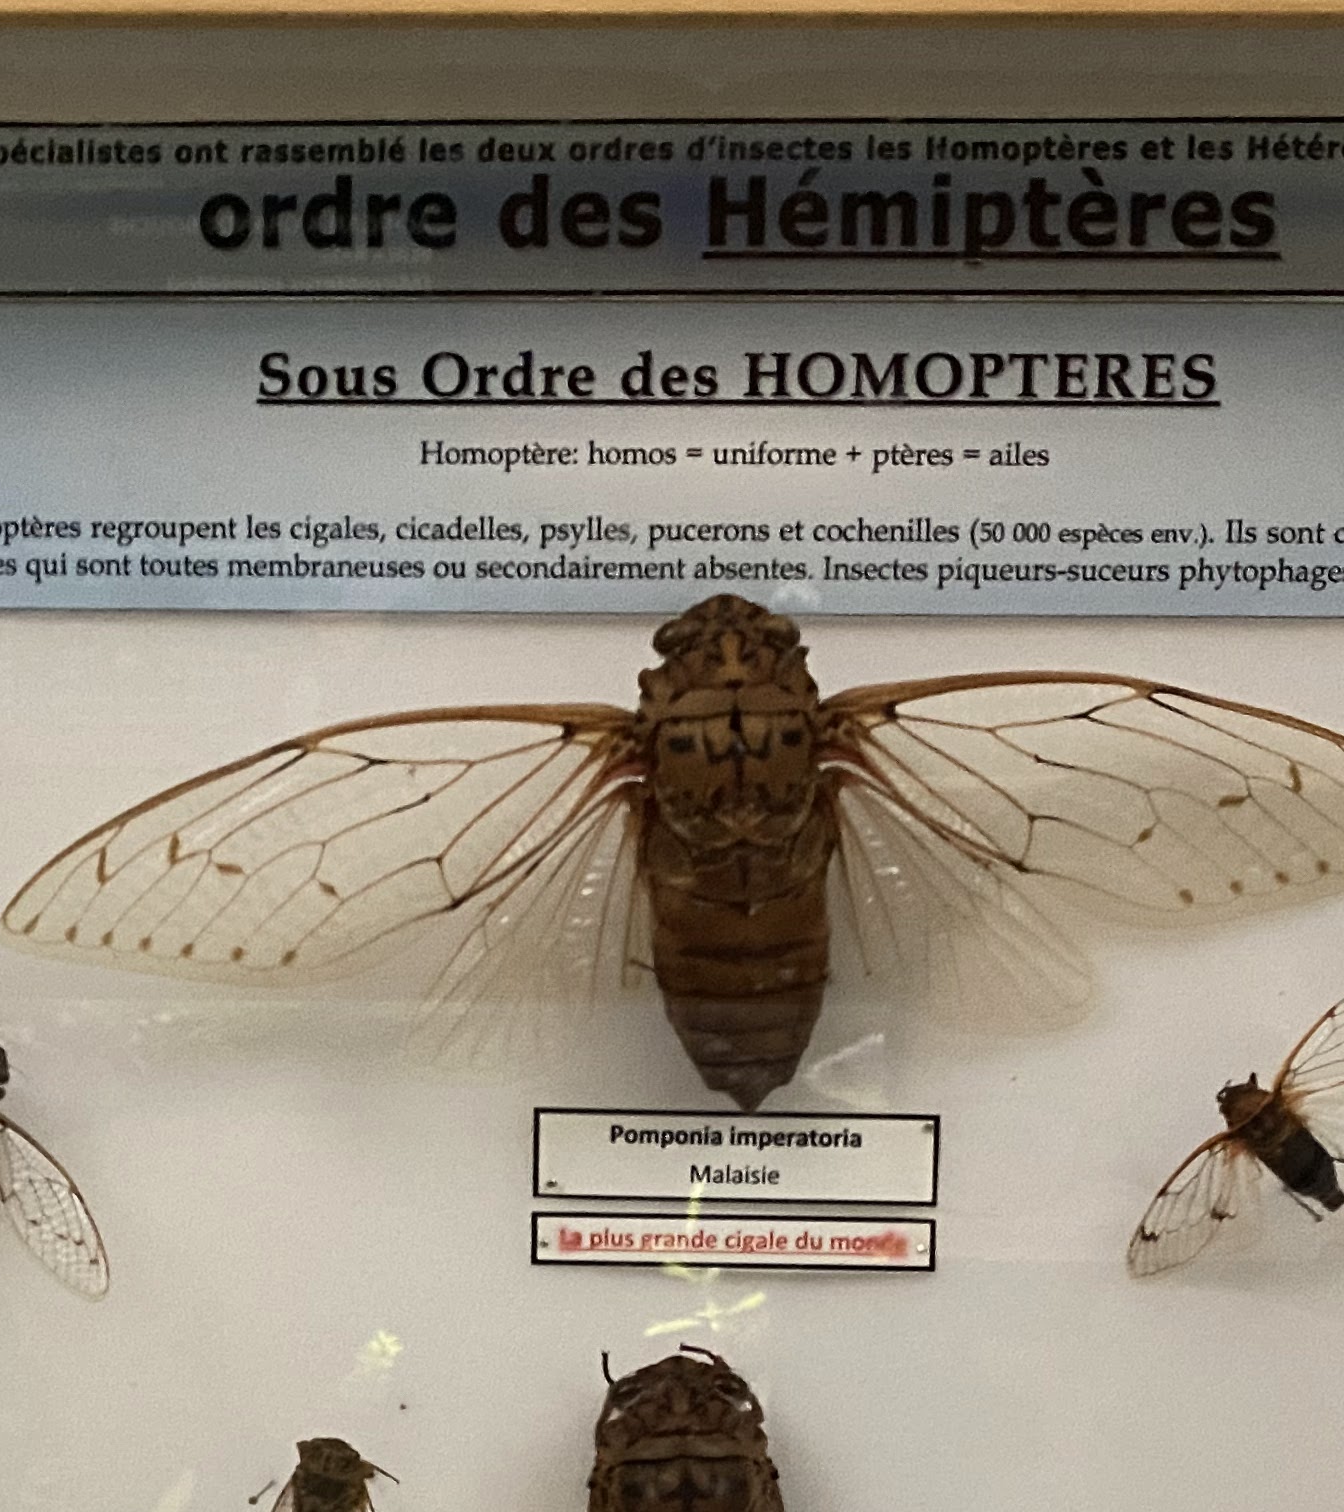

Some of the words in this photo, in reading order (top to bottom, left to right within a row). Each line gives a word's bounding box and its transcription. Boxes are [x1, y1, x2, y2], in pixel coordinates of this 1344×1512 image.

[173, 142, 229, 165] ont
[240, 138, 406, 165] rassemblé
[418, 138, 464, 165] les
[476, 138, 556, 165] deux
[567, 137, 674, 164] ordres
[867, 137, 913, 164] les
[926, 136, 1129, 169] Homoptères
[1140, 140, 1176, 163] et
[1187, 136, 1234, 163] les
[199, 173, 458, 249] ordre
[497, 172, 663, 248] des
[707, 168, 1277, 265] Hémiptères
[259, 350, 398, 397] Sous
[421, 350, 596, 398] Ordre
[620, 351, 718, 398] des
[744, 351, 1216, 399] HOMOPTERES
[420, 440, 578, 474] Homoptère:
[587, 440, 677, 467] homos
[712, 441, 838, 468] uniforme
[872, 441, 954, 475] ptères
[988, 441, 1050, 468] ailes
[90, 517, 237, 549] regroupent
[246, 513, 282, 542] les
[289, 513, 386, 550] cigales,
[395, 513, 529, 551] cicadelles,
[539, 514, 638, 551] psylles,
[648, 523, 771, 551] pucerons
[779, 519, 805, 544] et
[812, 515, 961, 544] cochenilles
[969, 515, 1006, 552] (50
[1012, 516, 1052, 545] 000
[1057, 516, 1145, 553] espèces
[1150, 516, 1215, 553] env.).
[1225, 516, 1258, 546] Ils
[1266, 521, 1327, 546] sont
[25, 549, 68, 586] qui
[75, 554, 132, 578] sont
[139, 554, 219, 578] toutes
[227, 550, 426, 579] membraneuses
[432, 559, 466, 579] ou
[475, 551, 687, 580] secondairement
[693, 551, 814, 581] absentes.
[823, 552, 929, 581] Insectes
[937, 552, 1171, 589] piqueurs-suceurs
[610, 1123, 723, 1150] Pomponia
[729, 1125, 863, 1152] imperatoria
[690, 1162, 780, 1186] Malaisie
[589, 1227, 634, 1249] plus
[640, 1230, 717, 1252] grande
[724, 1232, 788, 1253] cigale
[794, 1232, 824, 1252] du
